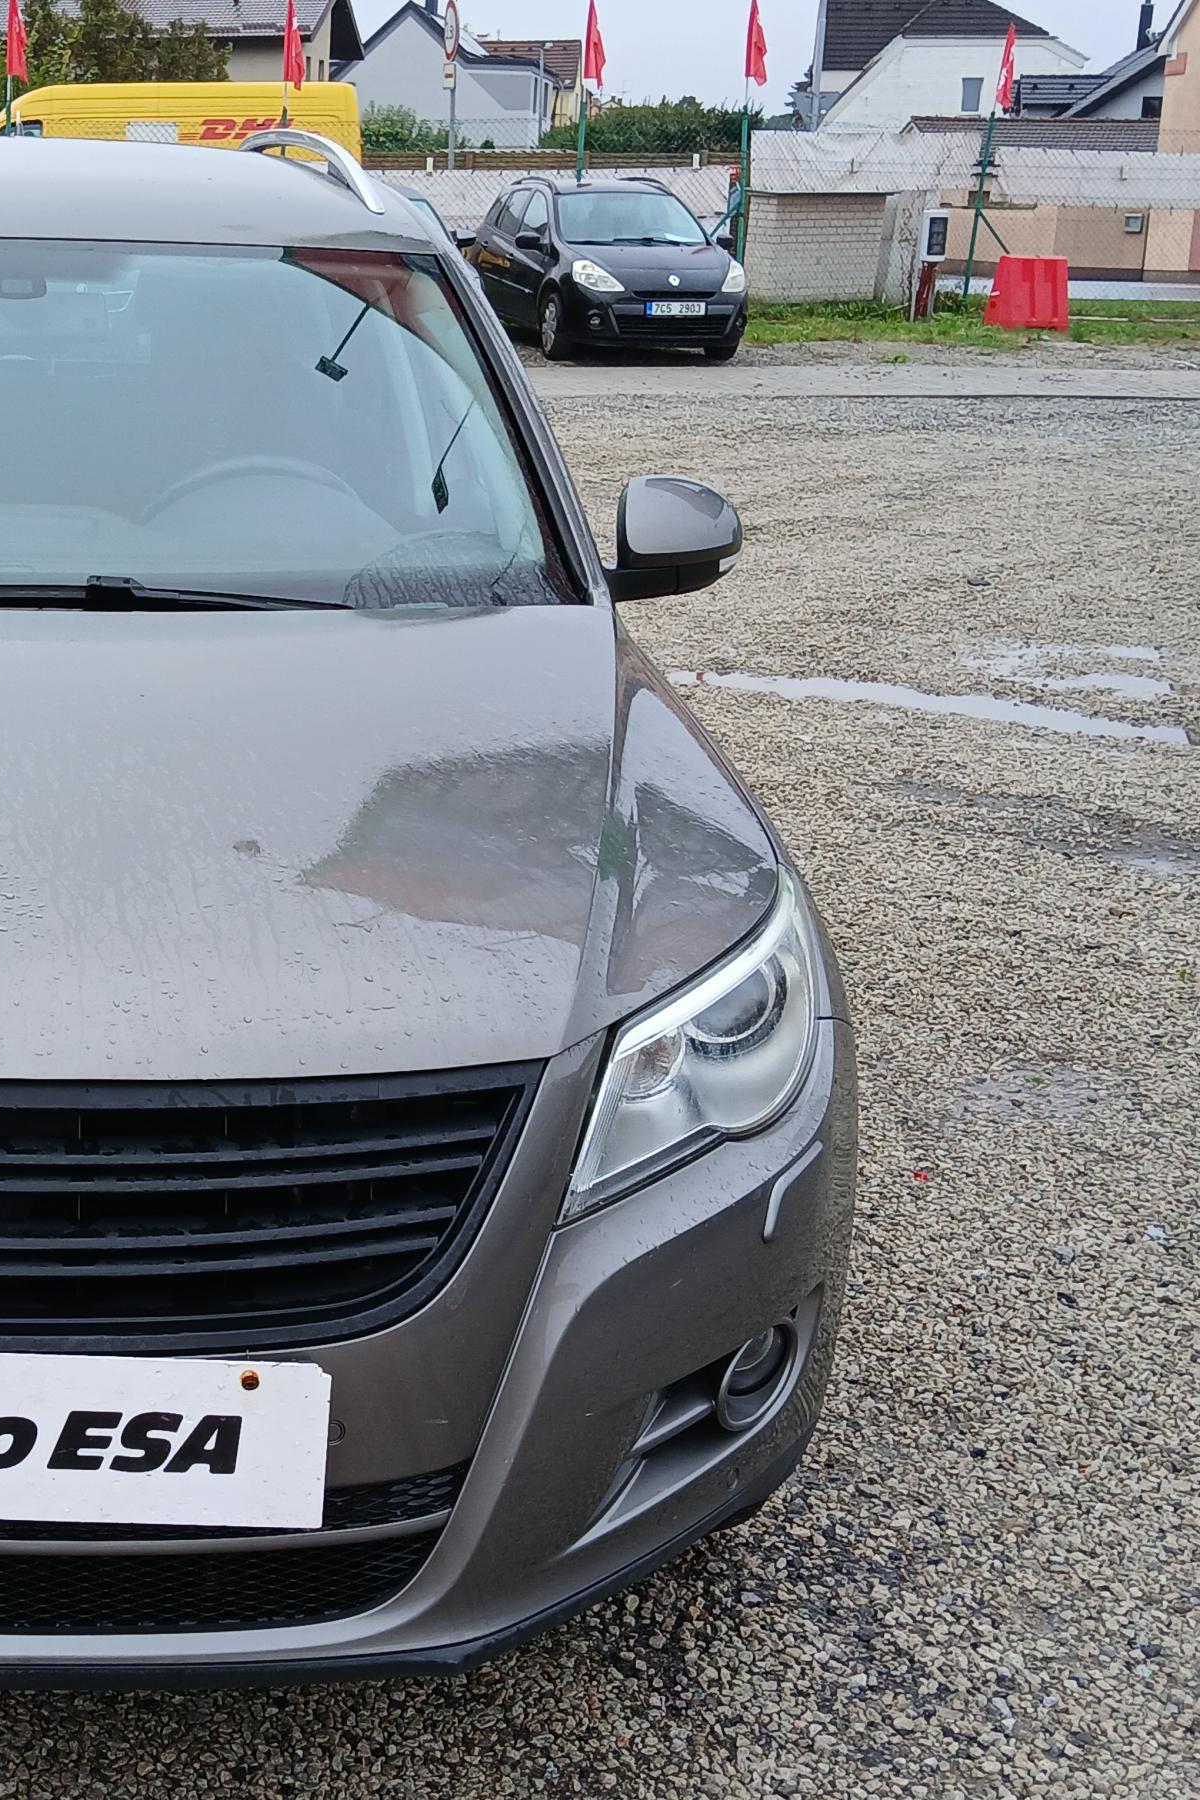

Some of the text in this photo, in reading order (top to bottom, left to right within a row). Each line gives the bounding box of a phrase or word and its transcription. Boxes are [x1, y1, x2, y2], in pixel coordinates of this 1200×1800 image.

[654, 303, 701, 314] 7C5 2903
[46, 1410, 243, 1475] ESA
